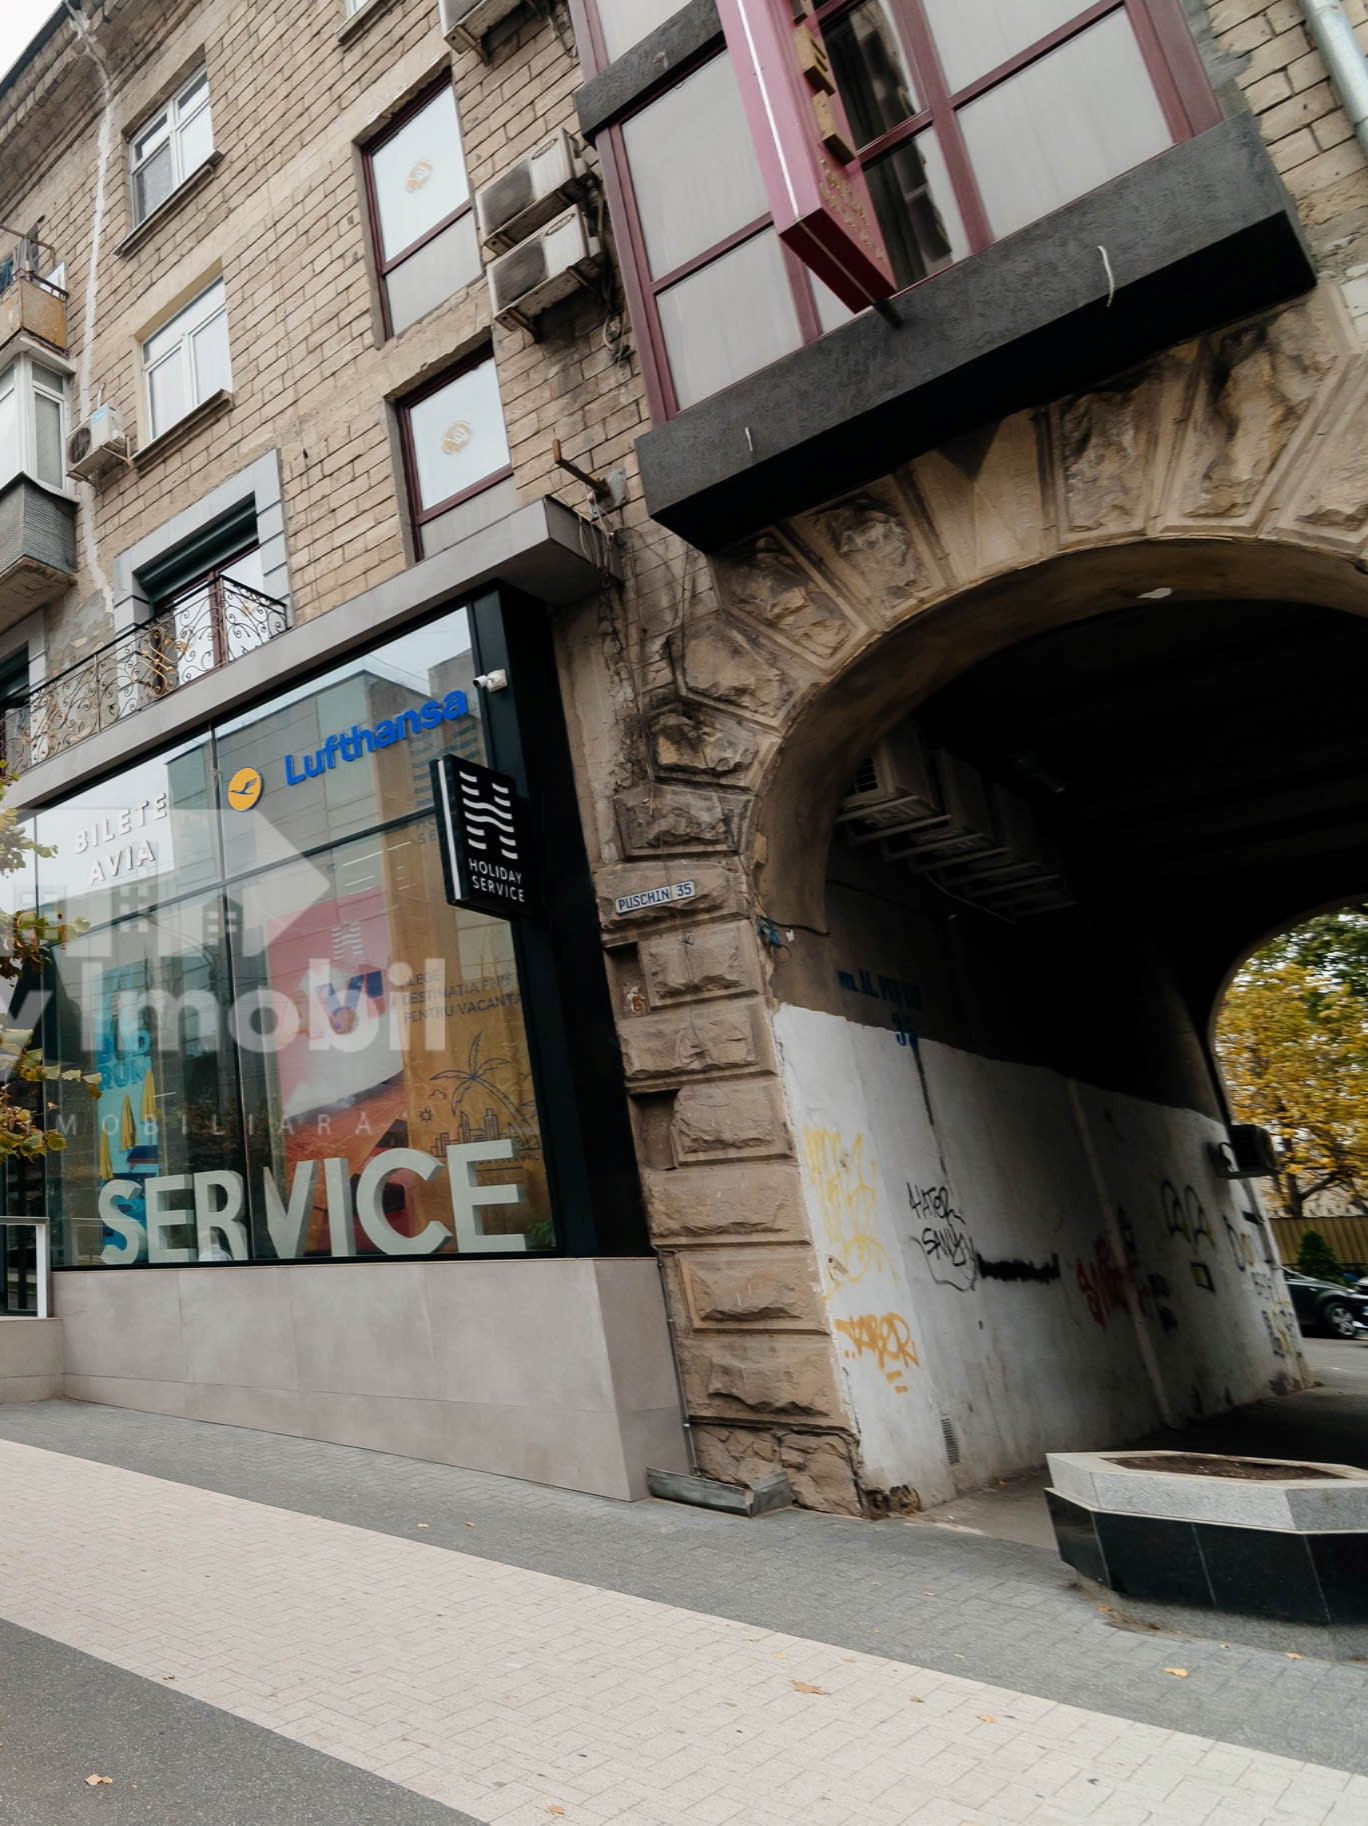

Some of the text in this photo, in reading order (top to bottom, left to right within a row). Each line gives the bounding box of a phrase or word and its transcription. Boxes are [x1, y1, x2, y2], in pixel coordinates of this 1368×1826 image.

[285, 689, 468, 787] Lufthansa
[75, 791, 169, 854] BILETE
[88, 839, 156, 886] AVIA
[468, 857, 523, 885] HOLIDAY
[472, 875, 525, 903] SERVICE
[618, 883, 692, 911] PUSCHIN 35
[97, 1138, 528, 1266] SERVICE
